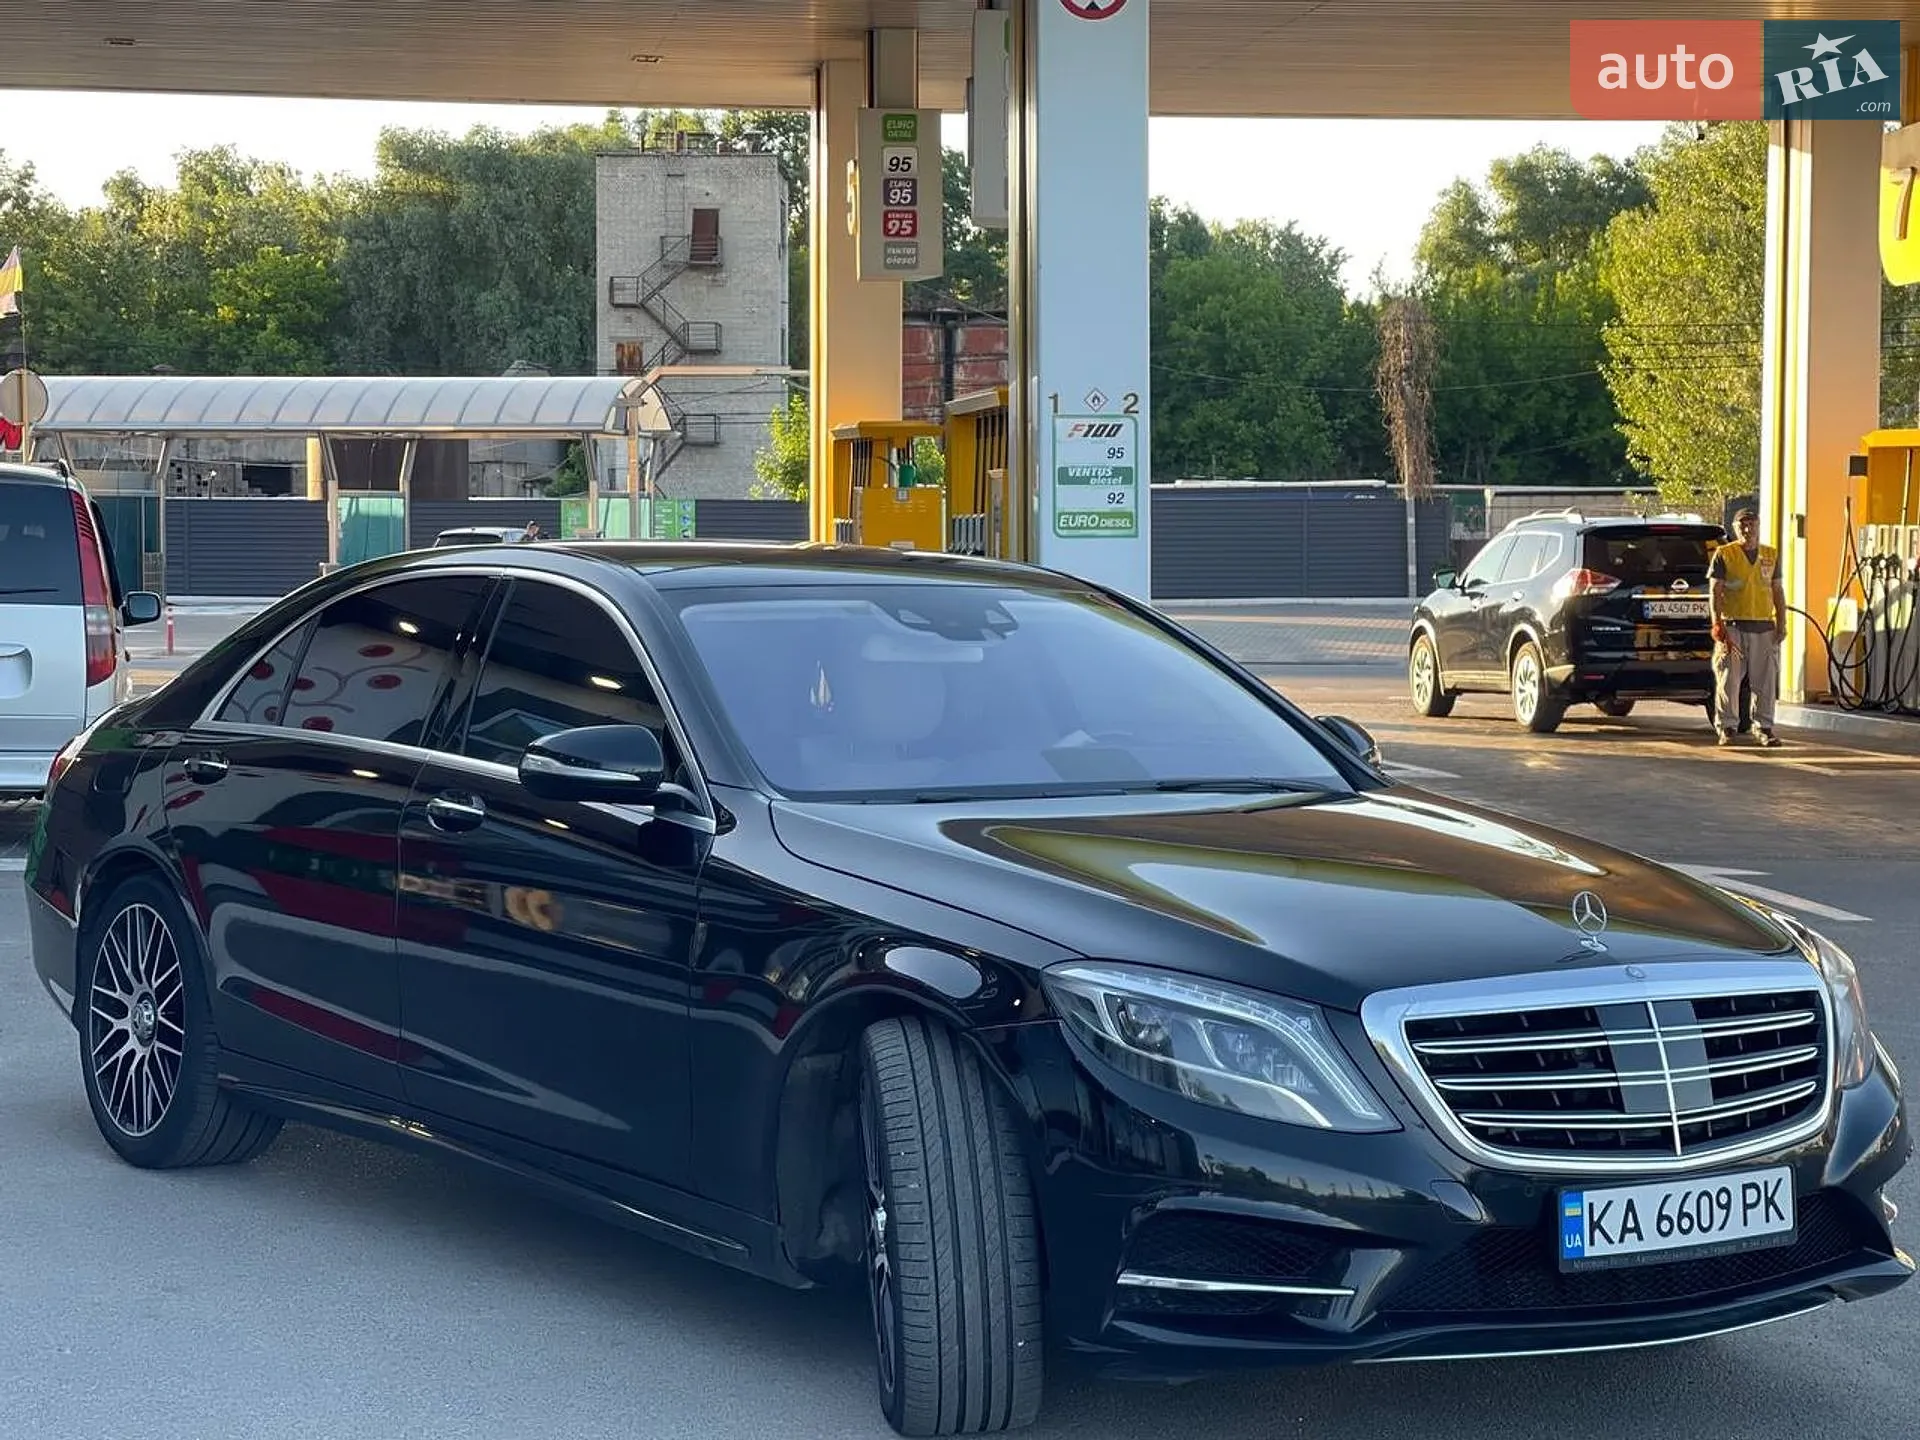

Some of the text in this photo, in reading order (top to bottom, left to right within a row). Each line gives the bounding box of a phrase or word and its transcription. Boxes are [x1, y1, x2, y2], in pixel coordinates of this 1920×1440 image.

[888, 156, 912, 172] 95
[889, 189, 912, 204] 95
[888, 220, 913, 235] 95
[1048, 393, 1059, 413] 1
[1123, 393, 1139, 413] 2
[1068, 423, 1123, 437] F100
[1107, 447, 1124, 459] 95
[1068, 467, 1112, 477] VENTUS
[1107, 492, 1124, 504] 92
[1059, 515, 1099, 527] EURO
[1588, 1178, 1785, 1247] KA 6609 PK
[1565, 1234, 1582, 1249] UA
